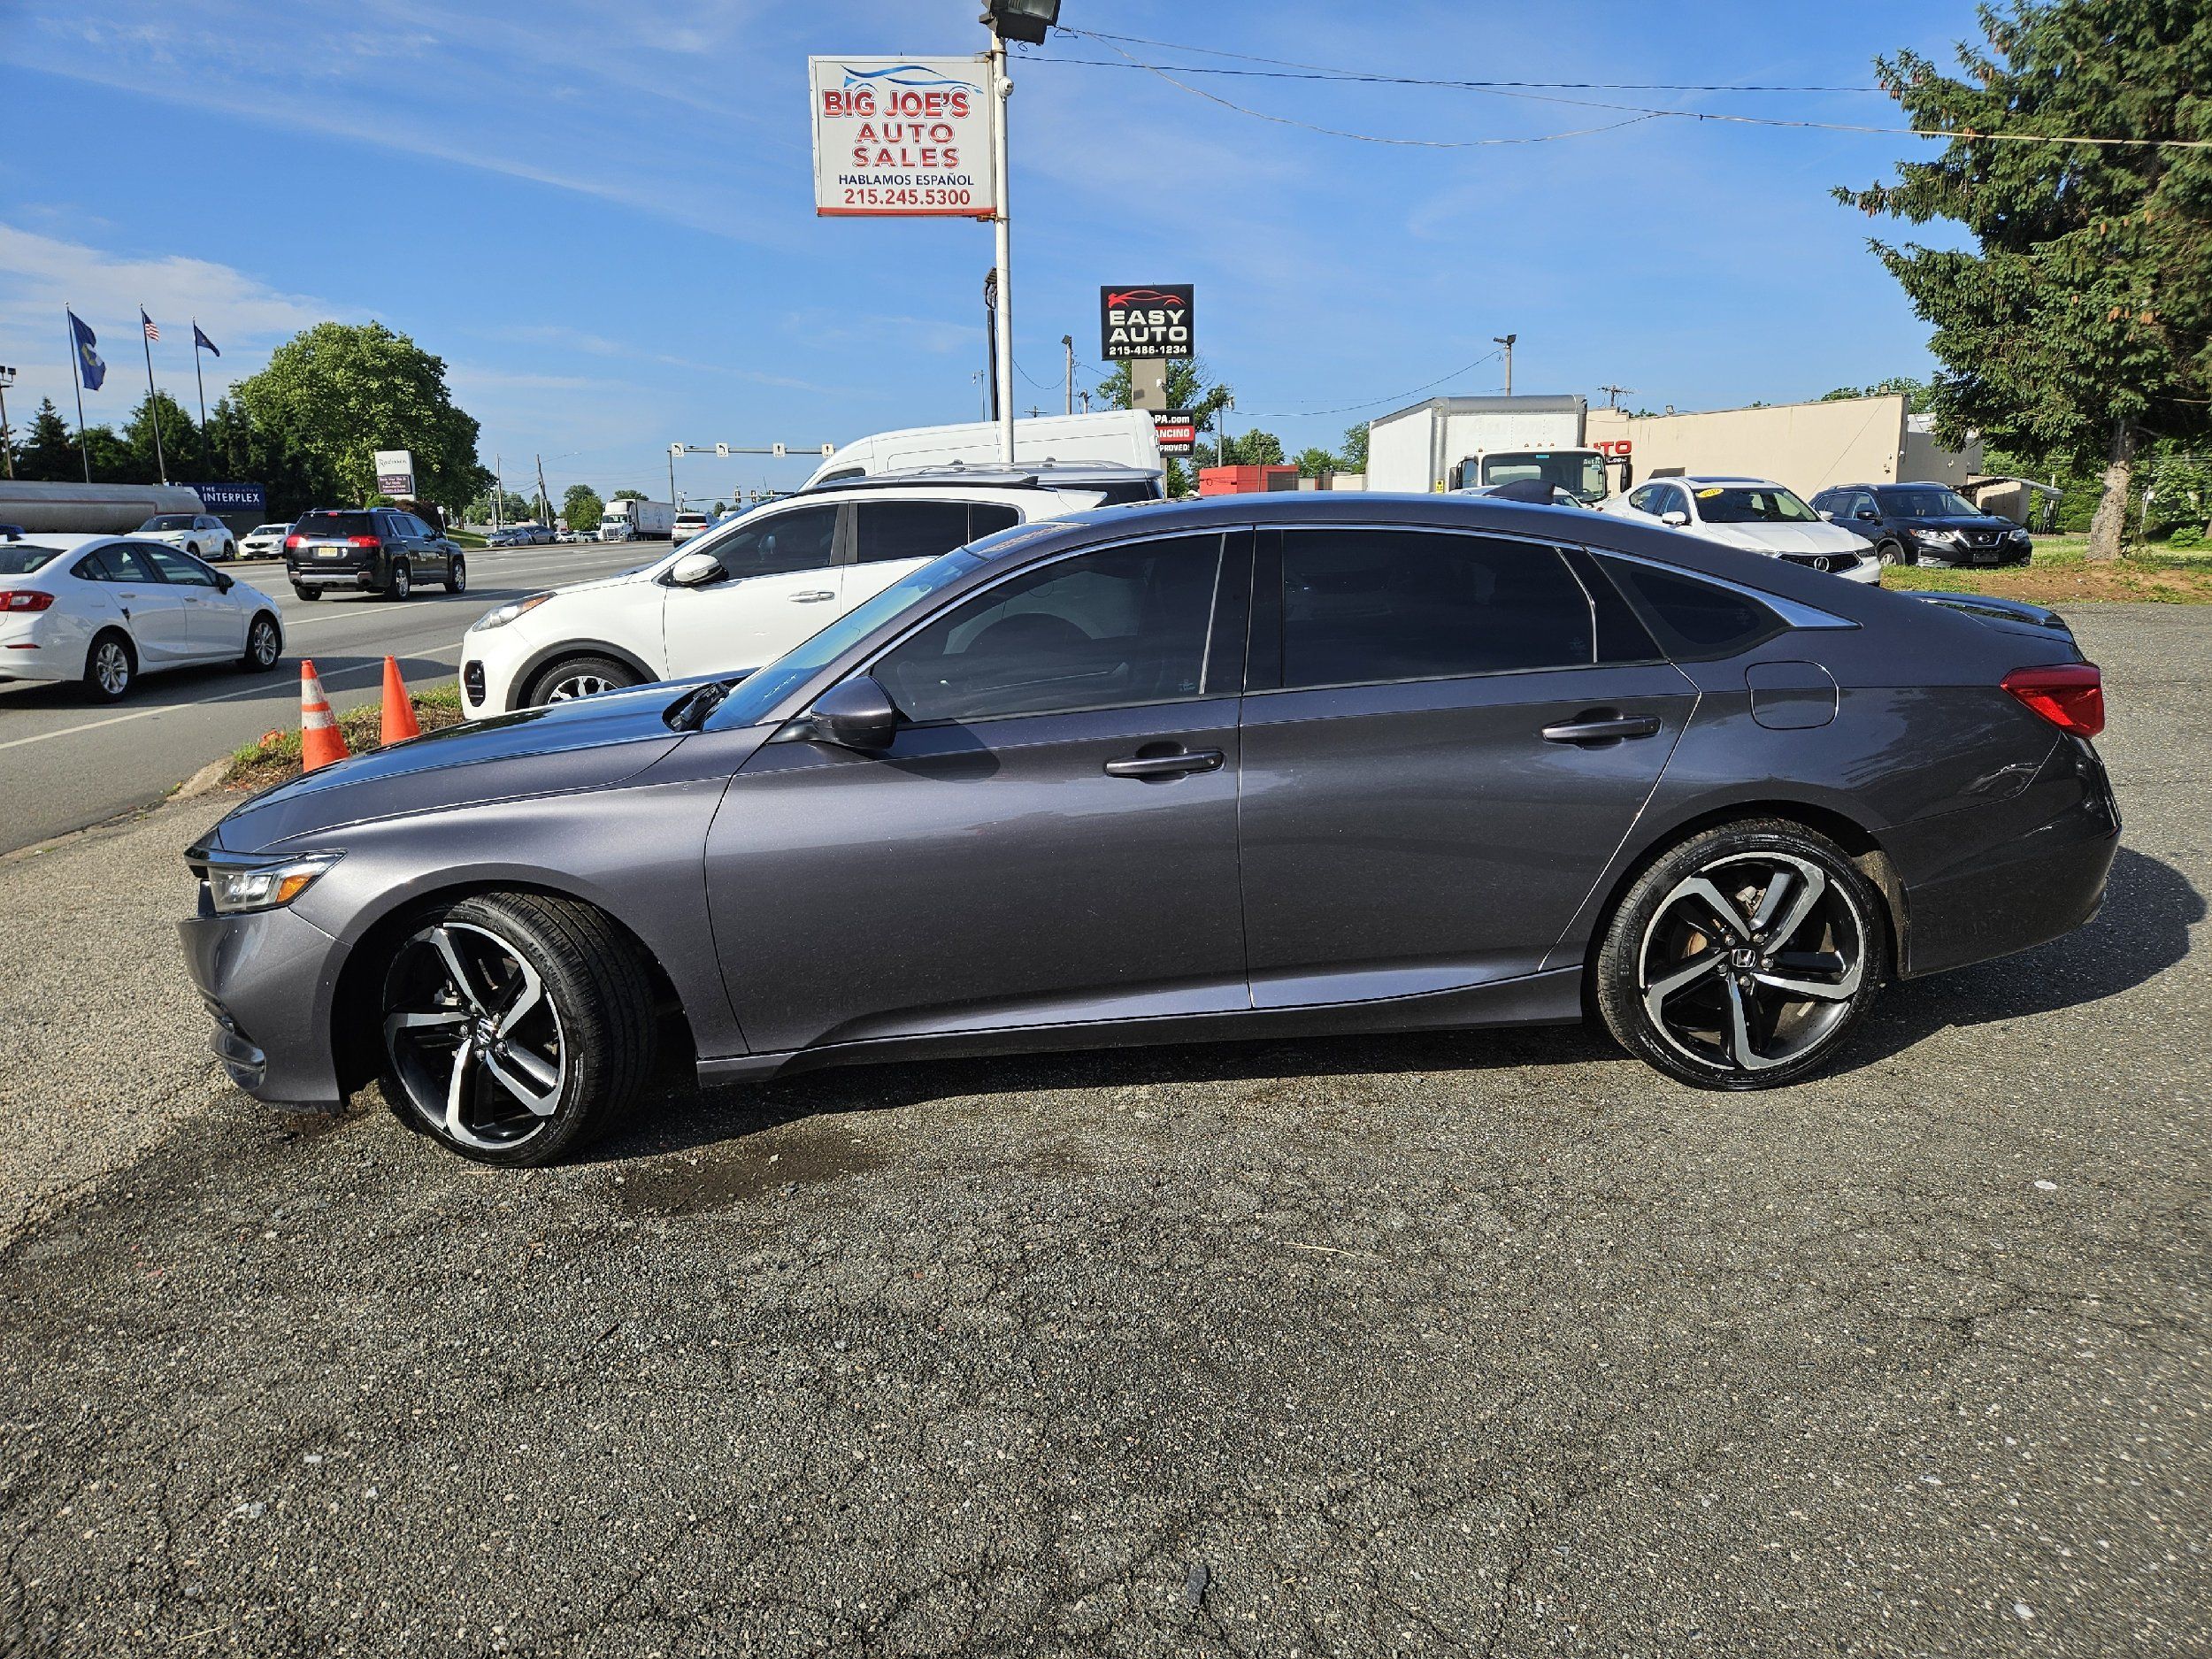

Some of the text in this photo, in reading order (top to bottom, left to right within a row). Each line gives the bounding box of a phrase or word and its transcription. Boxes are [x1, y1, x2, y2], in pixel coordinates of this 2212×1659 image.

[823, 90, 971, 119] BIG JOE'S
[856, 122, 955, 144] AUTO
[852, 147, 960, 168] SALES
[839, 173, 974, 186] HABLAMOS ESPAÑOL
[844, 188, 971, 204] 215.245.5300
[1110, 310, 1186, 326] EASY
[1110, 326, 1187, 342] AUTO
[1110, 345, 1187, 355] 215-486-1234
[203, 493, 260, 503] INTERPLEX
